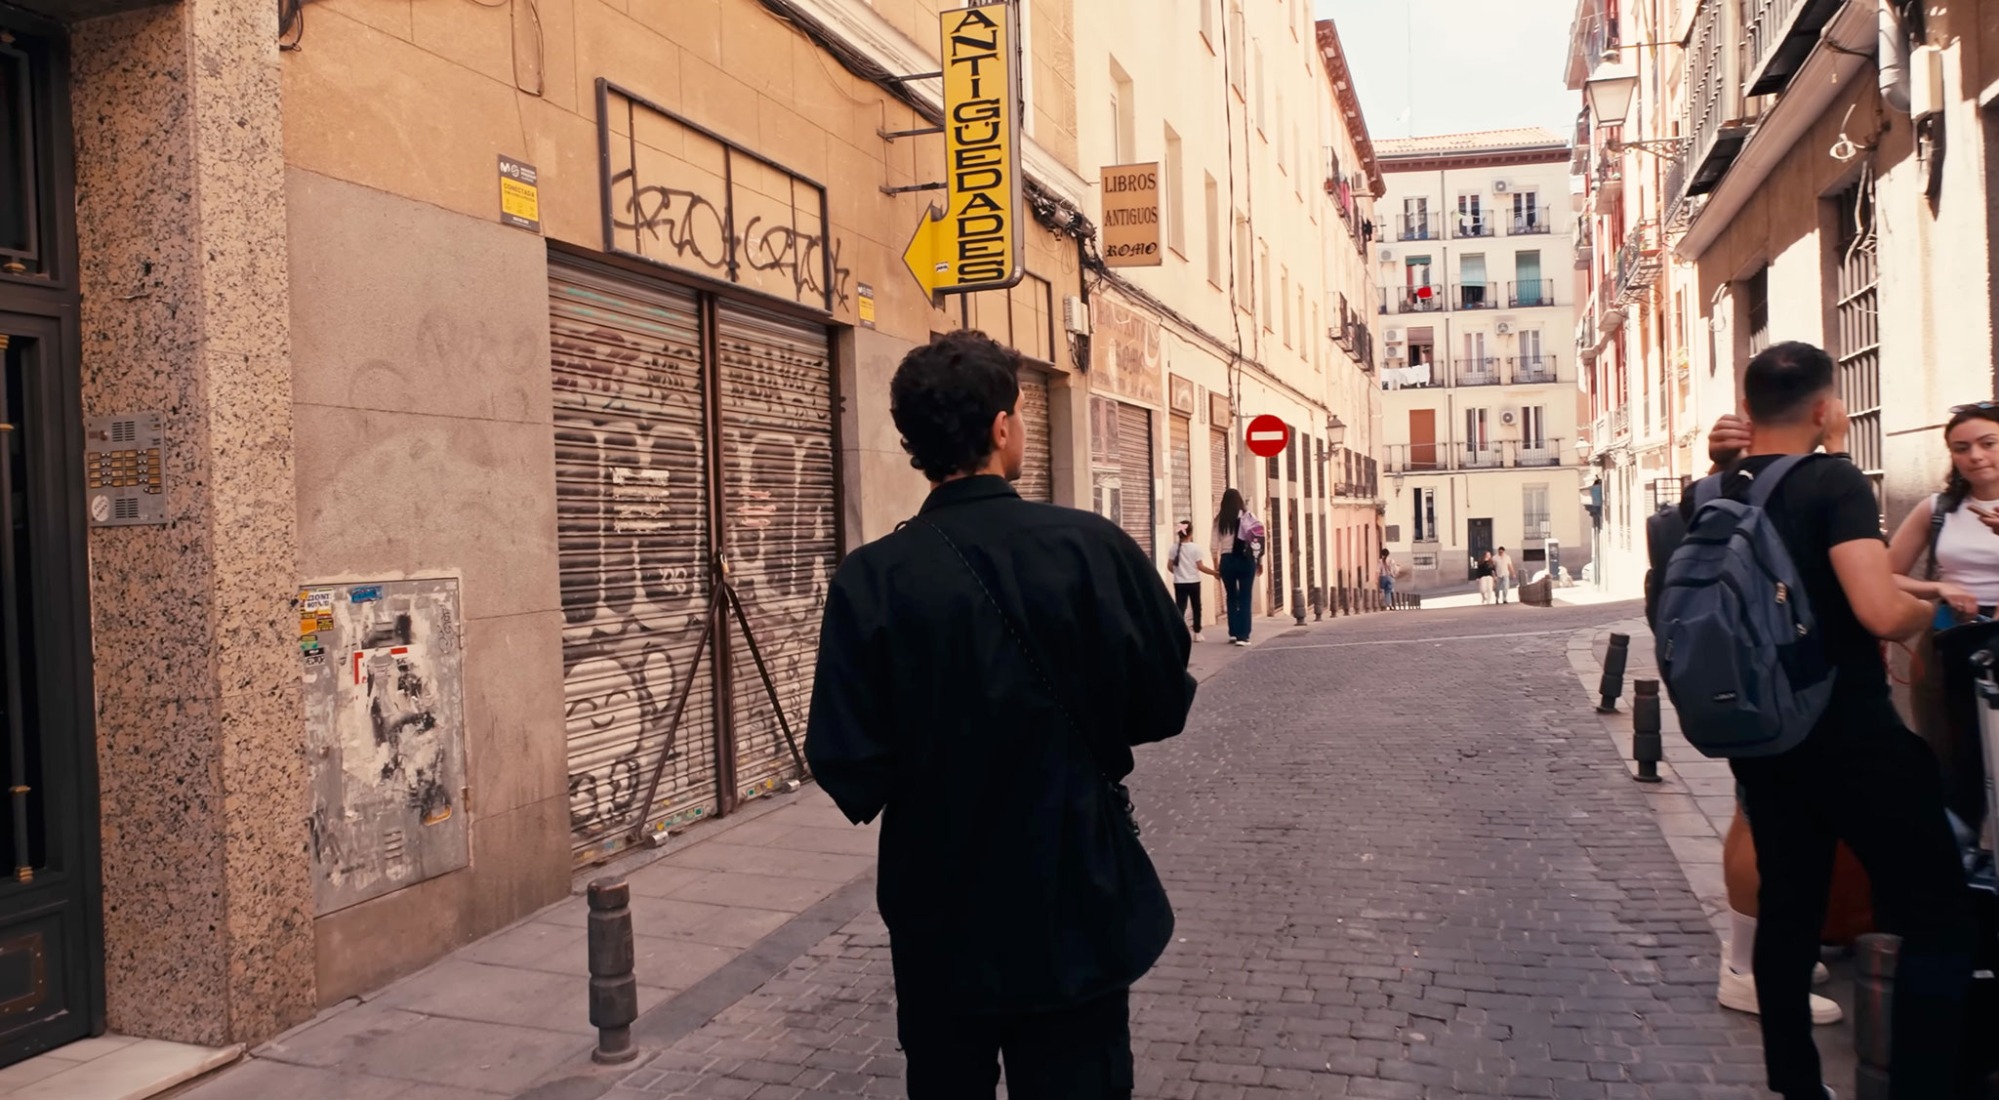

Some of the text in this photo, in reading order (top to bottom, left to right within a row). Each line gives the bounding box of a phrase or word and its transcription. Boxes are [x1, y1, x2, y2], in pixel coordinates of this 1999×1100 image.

[950, 9, 1005, 284] ANTIGÜEDADES
[1104, 172, 1157, 193] LIBROS
[1104, 206, 1158, 227] ANTIGUOS
[1106, 242, 1158, 257] ROMO
